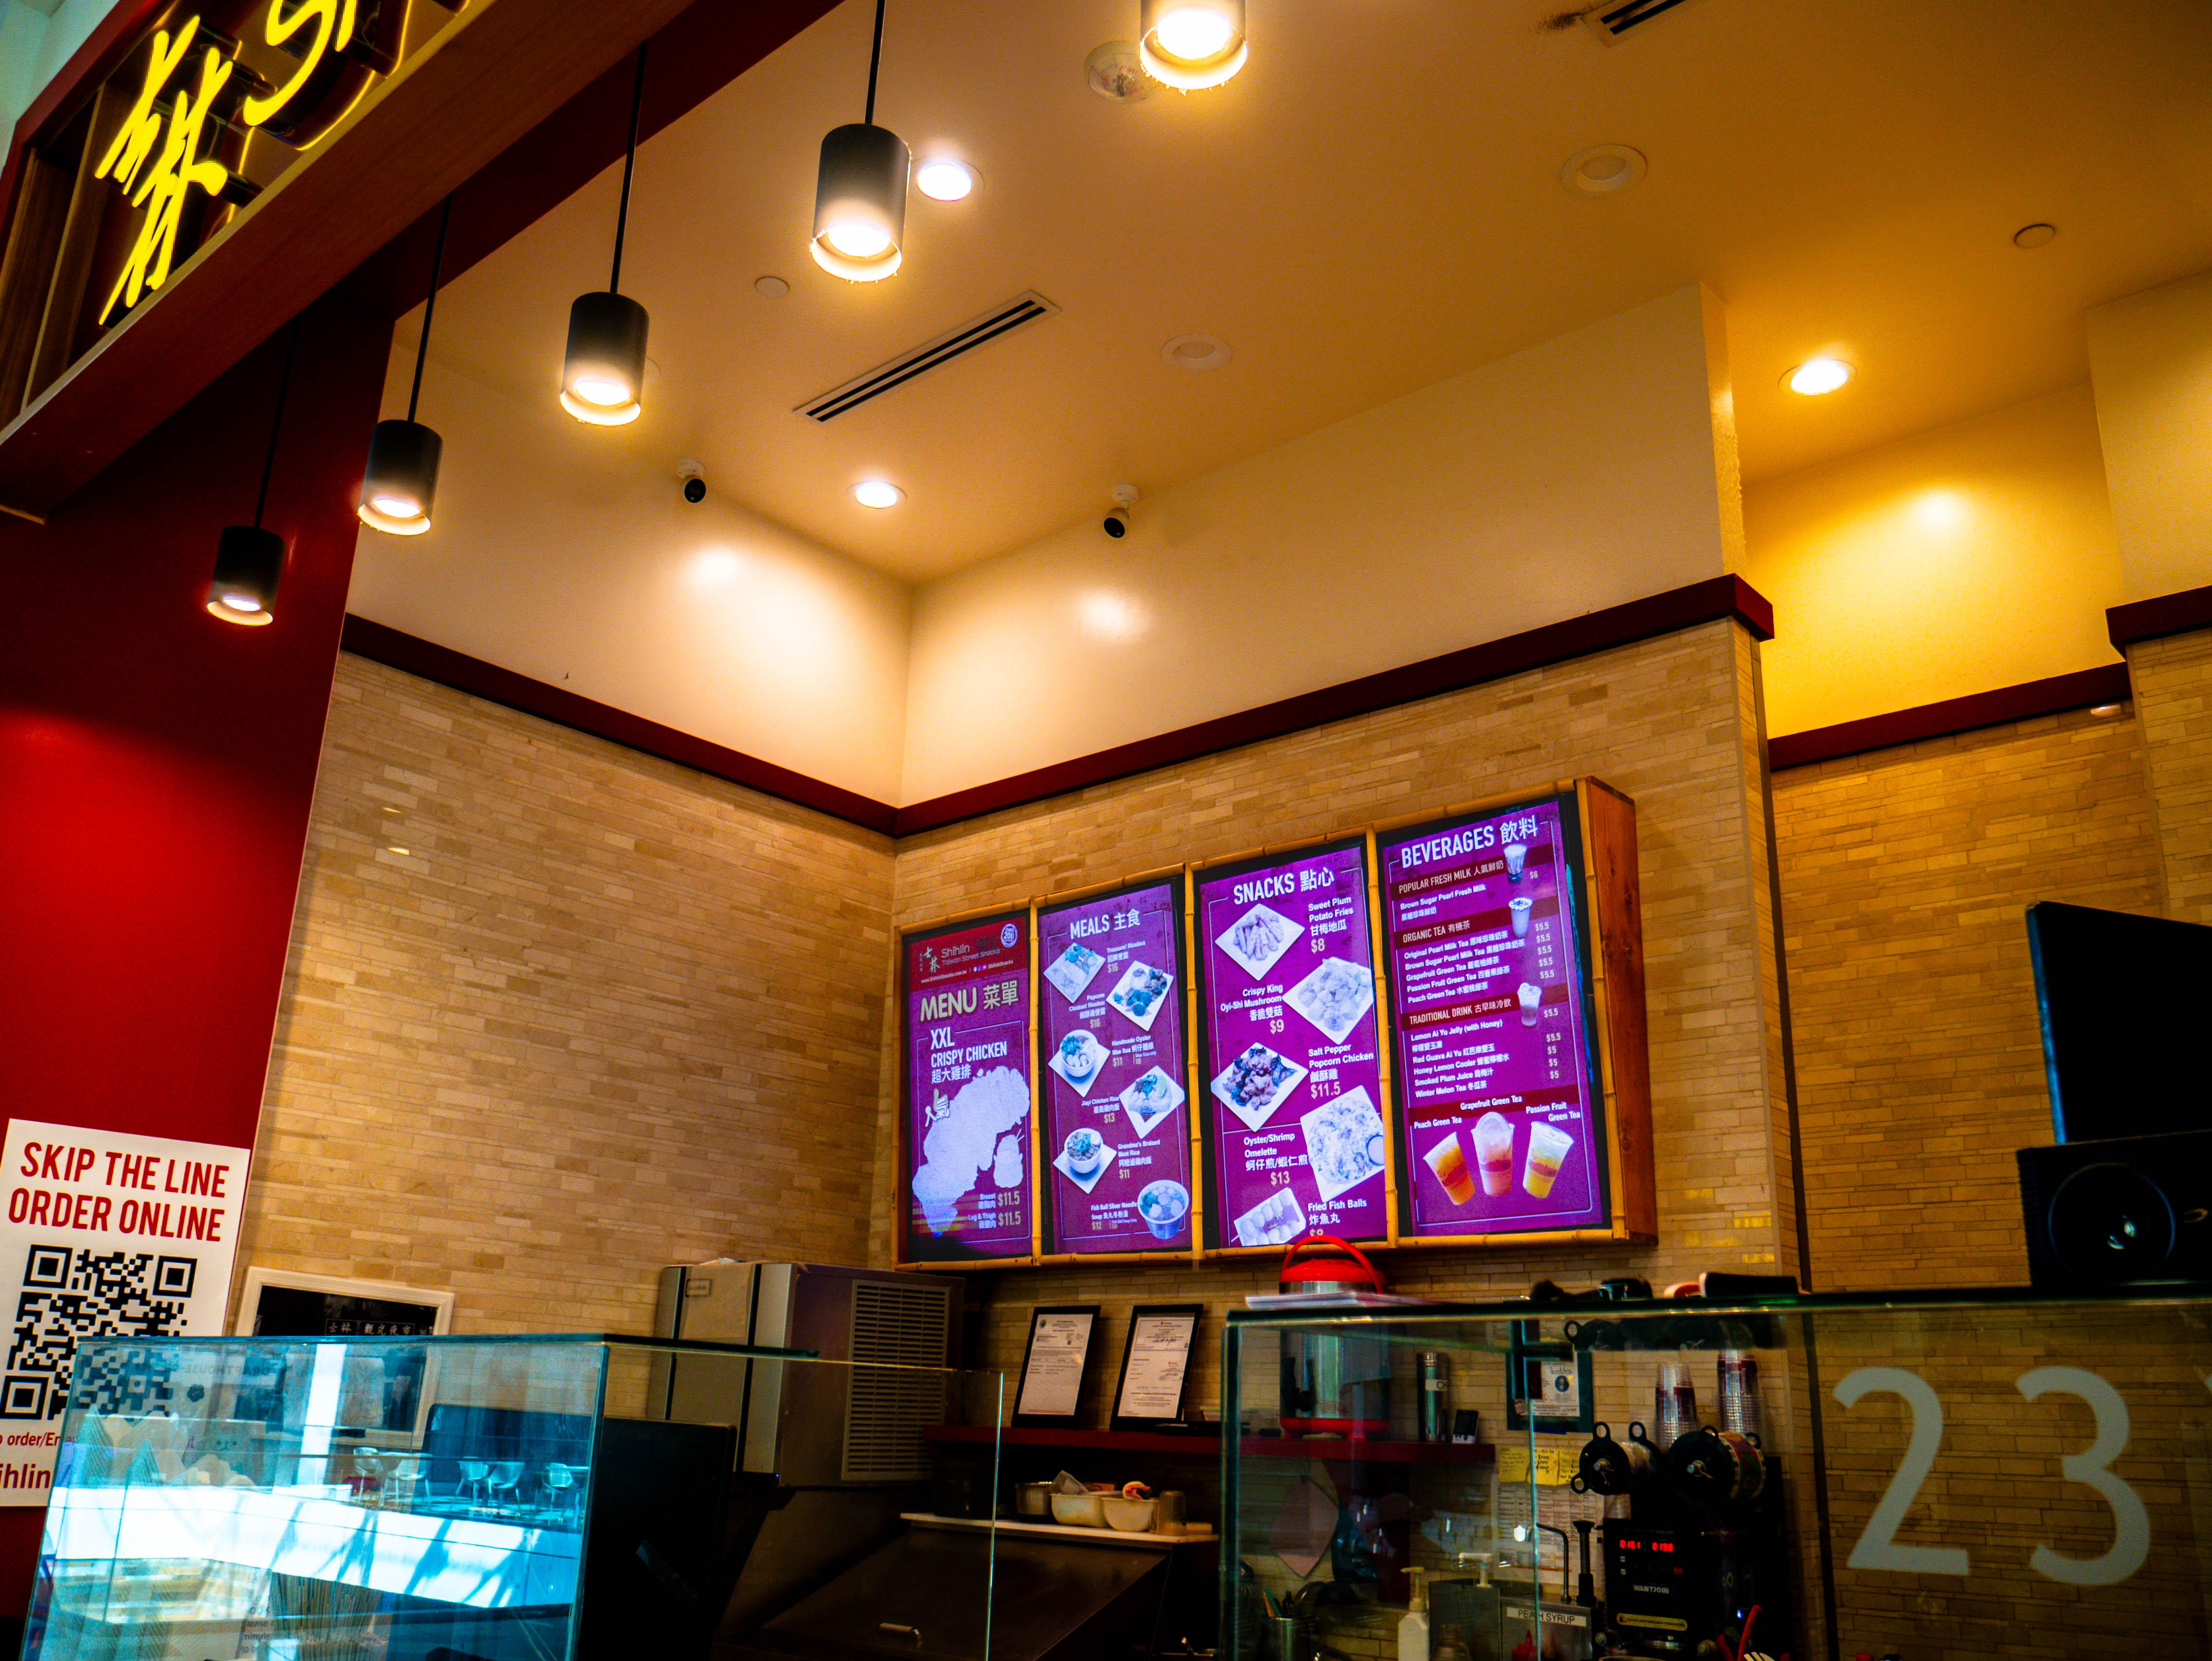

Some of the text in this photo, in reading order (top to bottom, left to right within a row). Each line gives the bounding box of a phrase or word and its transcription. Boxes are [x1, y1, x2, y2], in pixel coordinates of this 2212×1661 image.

[1401, 814, 1538, 868] BEVERAGES 飲料
[1398, 860, 1504, 894] POPULAR FRESH MILK 人氣鮮奶
[1530, 871, 1538, 879] $6
[1233, 867, 1335, 905] SNACKS 點心
[1400, 883, 1486, 910] Brown Sugar Pearl Fresh Milk
[1308, 897, 1352, 911] Sweet Plum
[1309, 907, 1354, 922] Potato Fries
[1070, 909, 1141, 939] MEALS 主食
[1310, 919, 1347, 937] 甘梅地瓜
[1535, 921, 1549, 932] $5.5
[1403, 920, 1470, 943] ORGANIC TEA 有機茶
[1536, 933, 1551, 943] $5.5
[941, 944, 970, 958] Shihlin
[1311, 938, 1325, 954] $8
[1404, 939, 1469, 959] Original Pearl Milk Tea
[1537, 945, 1552, 956] $5.5
[923, 947, 940, 973] 士林
[942, 949, 1000, 966] Taiwan Street Snacks
[1405, 948, 1485, 971] Brown Sugar Pearl Milk Tea
[1538, 957, 1553, 967] $5.5
[1406, 963, 1467, 982] Grapefruit Green Tea
[1540, 969, 1554, 979] $5.5
[1407, 972, 1477, 993] Passion Fruit Green Tea
[1242, 984, 1283, 997] Crispy King
[920, 980, 1018, 1022] MENU 菜單
[1221, 996, 1281, 1013] Oyi-Shi Mushroom
[1408, 994, 1426, 1004] Peach
[1409, 1005, 1473, 1025] TRADITIONAL DRINK
[1543, 1008, 1558, 1018] $5.5
[1270, 1019, 1284, 1035] $9
[1411, 1032, 1432, 1041] Lemon
[1449, 1026, 1463, 1035] Jelly
[1464, 1023, 1479, 1033] (with
[1480, 1019, 1503, 1030] Honey)
[931, 1027, 955, 1050] XXL
[1111, 1037, 1135, 1046] Handmade
[1546, 1033, 1561, 1042] $5.5
[931, 1041, 1007, 1068] CRISPY CHICKEN
[1308, 1044, 1352, 1056] Salt Pepper
[1547, 1045, 1556, 1055] $5
[1309, 1052, 1374, 1069] Popcorn Chicken
[1413, 1055, 1425, 1064] Red
[1426, 1053, 1445, 1062] Guava
[1548, 1058, 1558, 1067] $5
[931, 1064, 971, 1084] 超大雞排
[1414, 1059, 1476, 1075] Honey Lemon Cooler
[1415, 1072, 1473, 1086] Smoked Plum Juice
[1550, 1070, 1559, 1079] $5
[1311, 1081, 1340, 1100] $11.5
[1415, 1089, 1436, 1098] Winter
[1436, 1086, 1455, 1095] Melon
[1460, 1099, 1491, 1111] Grapefruit
[1492, 1097, 1510, 1106] Green
[1526, 1101, 1567, 1114] Passion Fruit
[1104, 1112, 1115, 1123] $13
[1414, 1121, 1432, 1129] Peach
[1433, 1118, 1450, 1127] Green
[1548, 1111, 1581, 1122] Green Tea
[1143, 1138, 1160, 1147] Braised
[1243, 1133, 1296, 1146] Oyster/Shrimp
[1244, 1147, 1277, 1158] Omelette
[20, 1141, 230, 1198] SKIP THE LINE
[1119, 1169, 1129, 1179] $11
[1271, 1171, 1290, 1187] $13
[998, 1191, 1020, 1207] $11.5
[1308, 1198, 1367, 1212] Fried Fish Balls
[8, 1188, 225, 1242] ORDER ONLINE
[998, 1211, 1021, 1227] $11.5
[1309, 1212, 1340, 1225] 炸魚丸
[1832, 1367, 2212, 1585] 23
[1633, 1584, 1669, 1594] WANTJOIN
[1518, 1609, 1575, 1623] PEAH SYRUP
